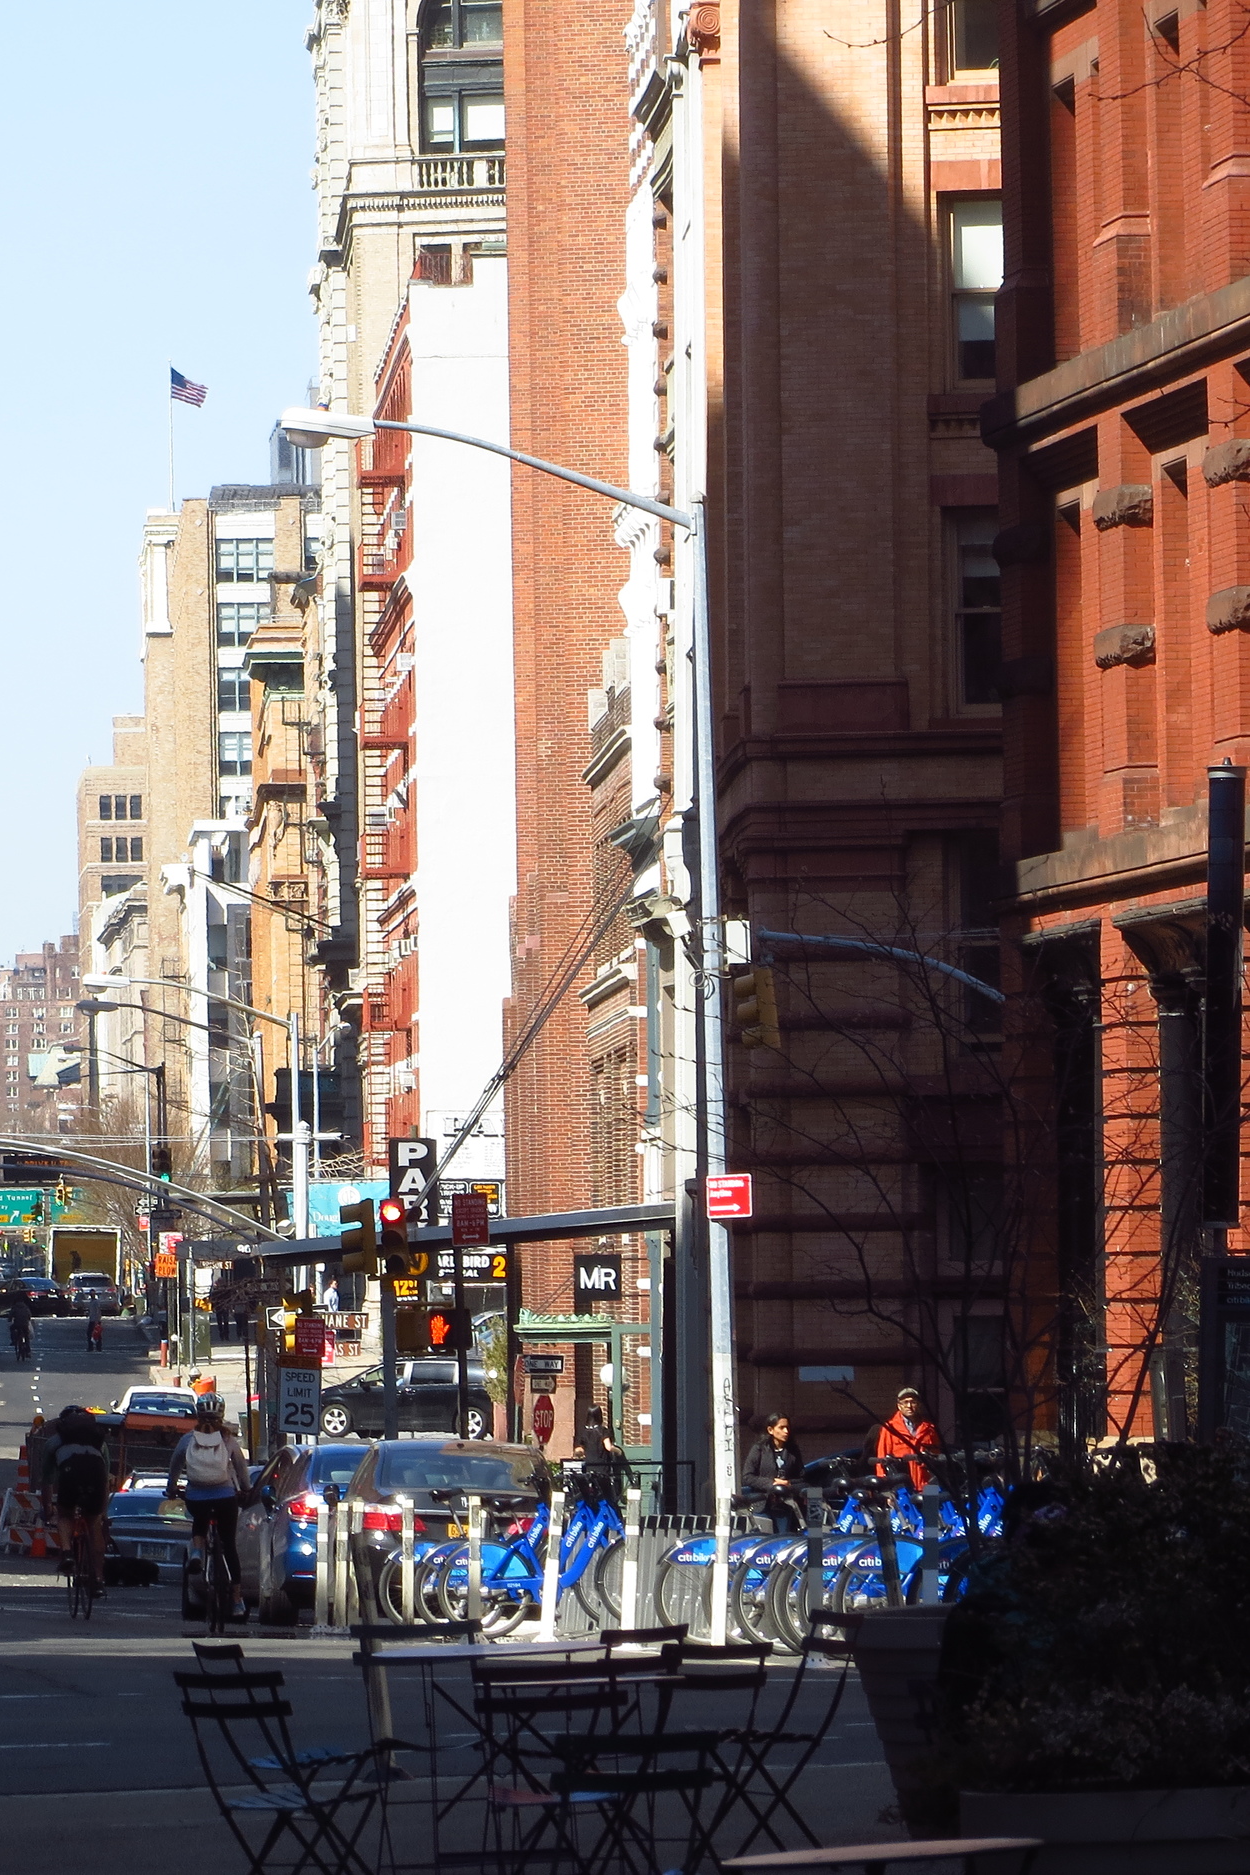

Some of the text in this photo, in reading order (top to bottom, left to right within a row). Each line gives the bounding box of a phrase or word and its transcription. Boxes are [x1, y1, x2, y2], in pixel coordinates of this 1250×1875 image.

[462, 1255, 490, 1268] BIRD
[354, 1315, 367, 1328] ST
[349, 1344, 359, 1356] ST
[525, 1360, 559, 1369] ONE WAY
[285, 1372, 315, 1382] SPEED
[287, 1388, 313, 1398] LIMIT
[284, 1402, 315, 1427] 25
[534, 1412, 553, 1428] STOP
